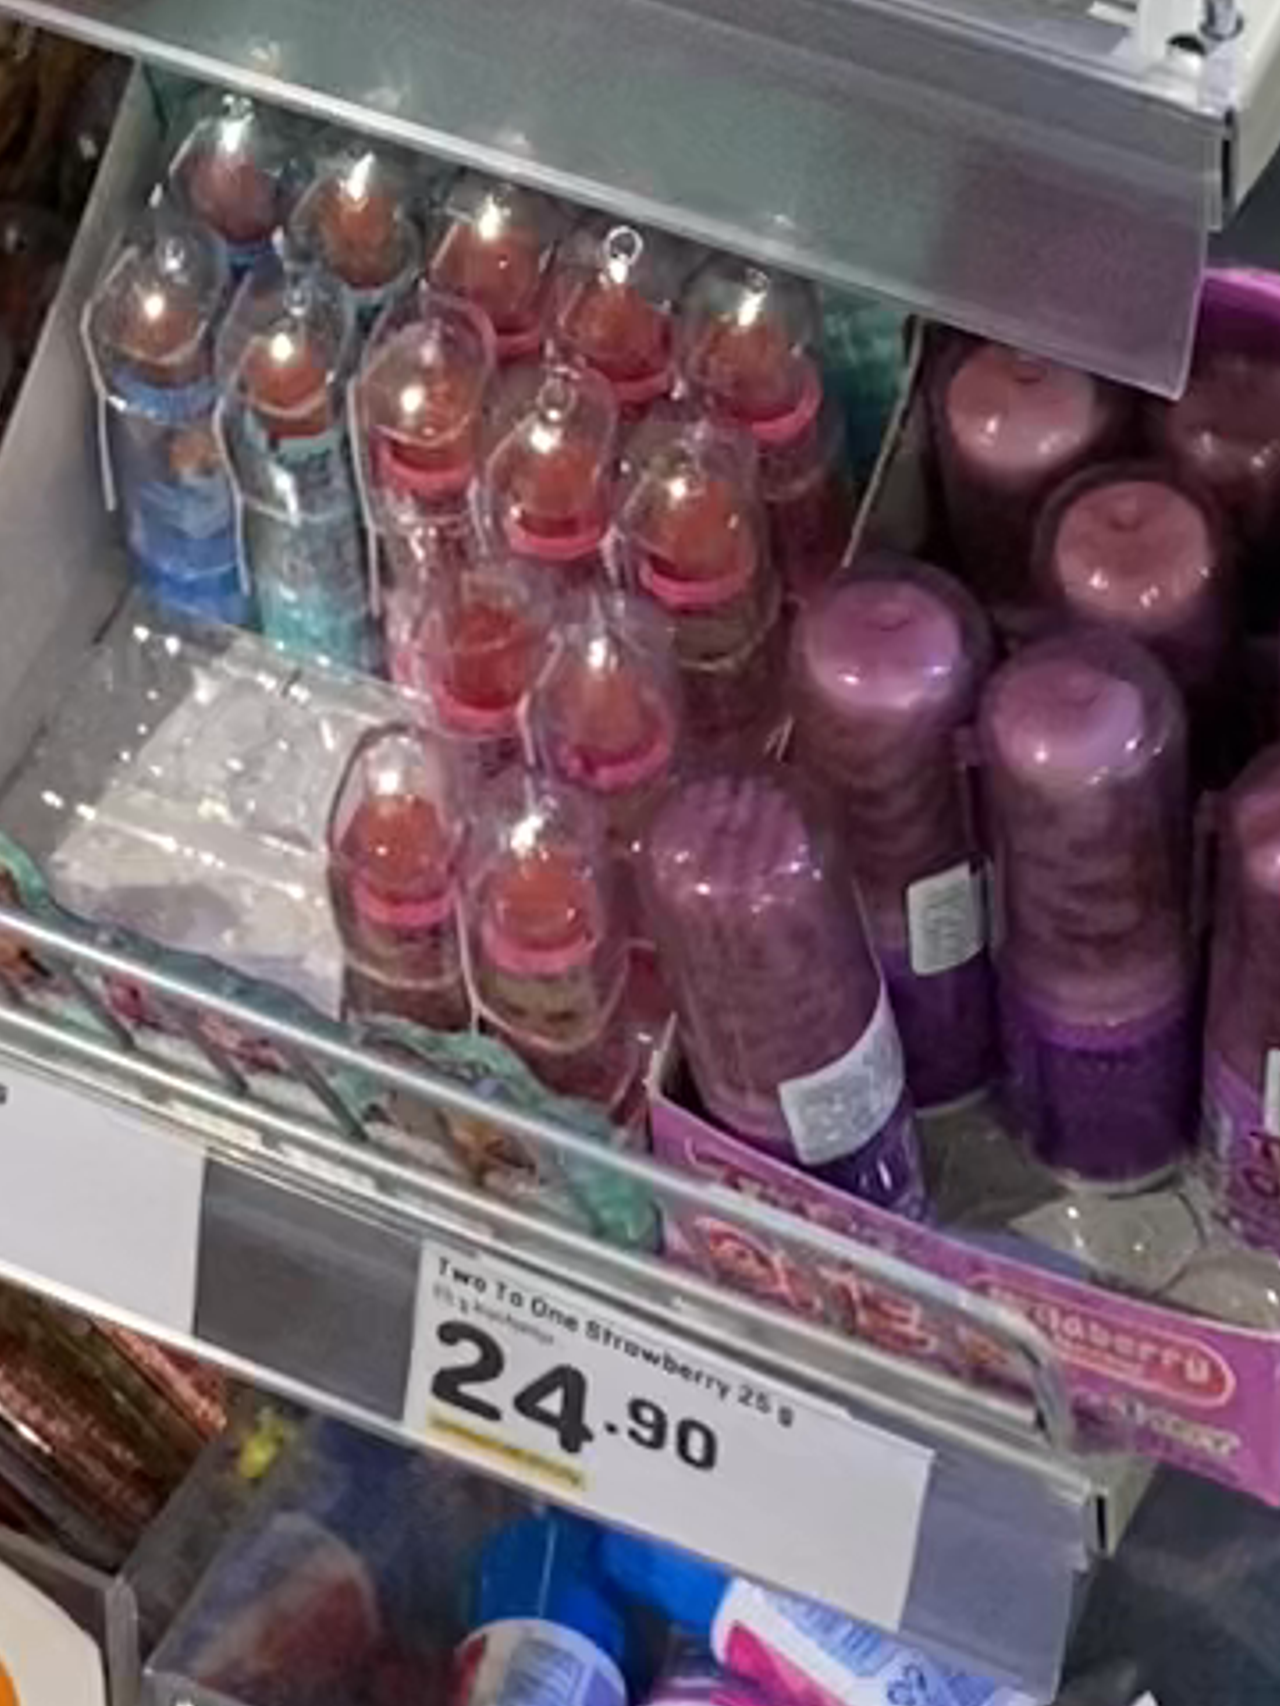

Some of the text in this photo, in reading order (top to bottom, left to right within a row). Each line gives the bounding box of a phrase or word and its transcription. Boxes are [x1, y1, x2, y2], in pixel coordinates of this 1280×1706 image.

[430, 1319, 719, 1472] 24.90
[437, 1256, 487, 1295] Two
[495, 1278, 524, 1310] To
[530, 1296, 580, 1335] One
[584, 1318, 731, 1401] Strawberry
[736, 1383, 773, 1417] 25
[778, 1403, 796, 1429] g
